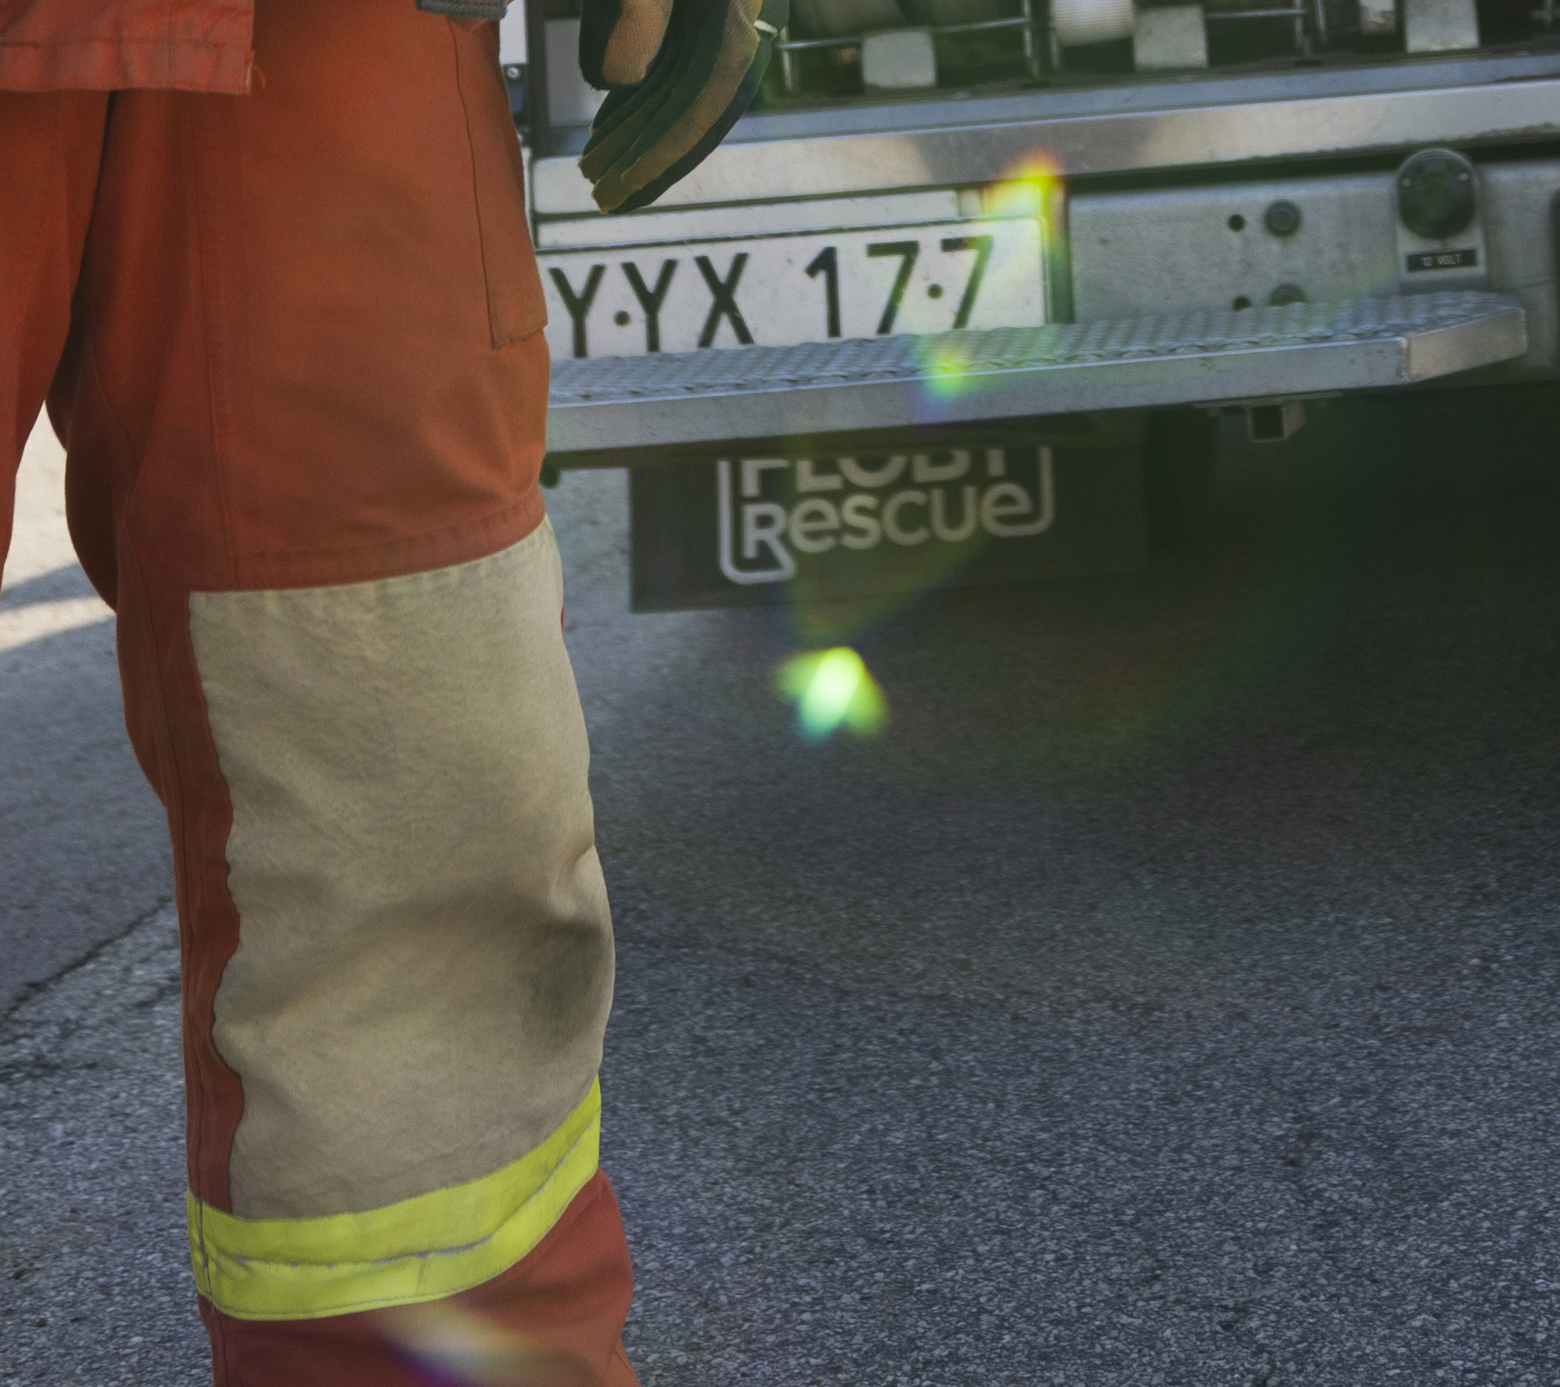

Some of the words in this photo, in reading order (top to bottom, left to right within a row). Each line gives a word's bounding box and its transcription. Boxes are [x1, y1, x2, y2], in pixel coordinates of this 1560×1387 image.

[549, 252, 756, 359] YYX
[804, 235, 993, 339] 177
[1422, 256, 1433, 266] 12
[1437, 253, 1462, 265] VOLT
[743, 482, 1034, 559] Rescue
